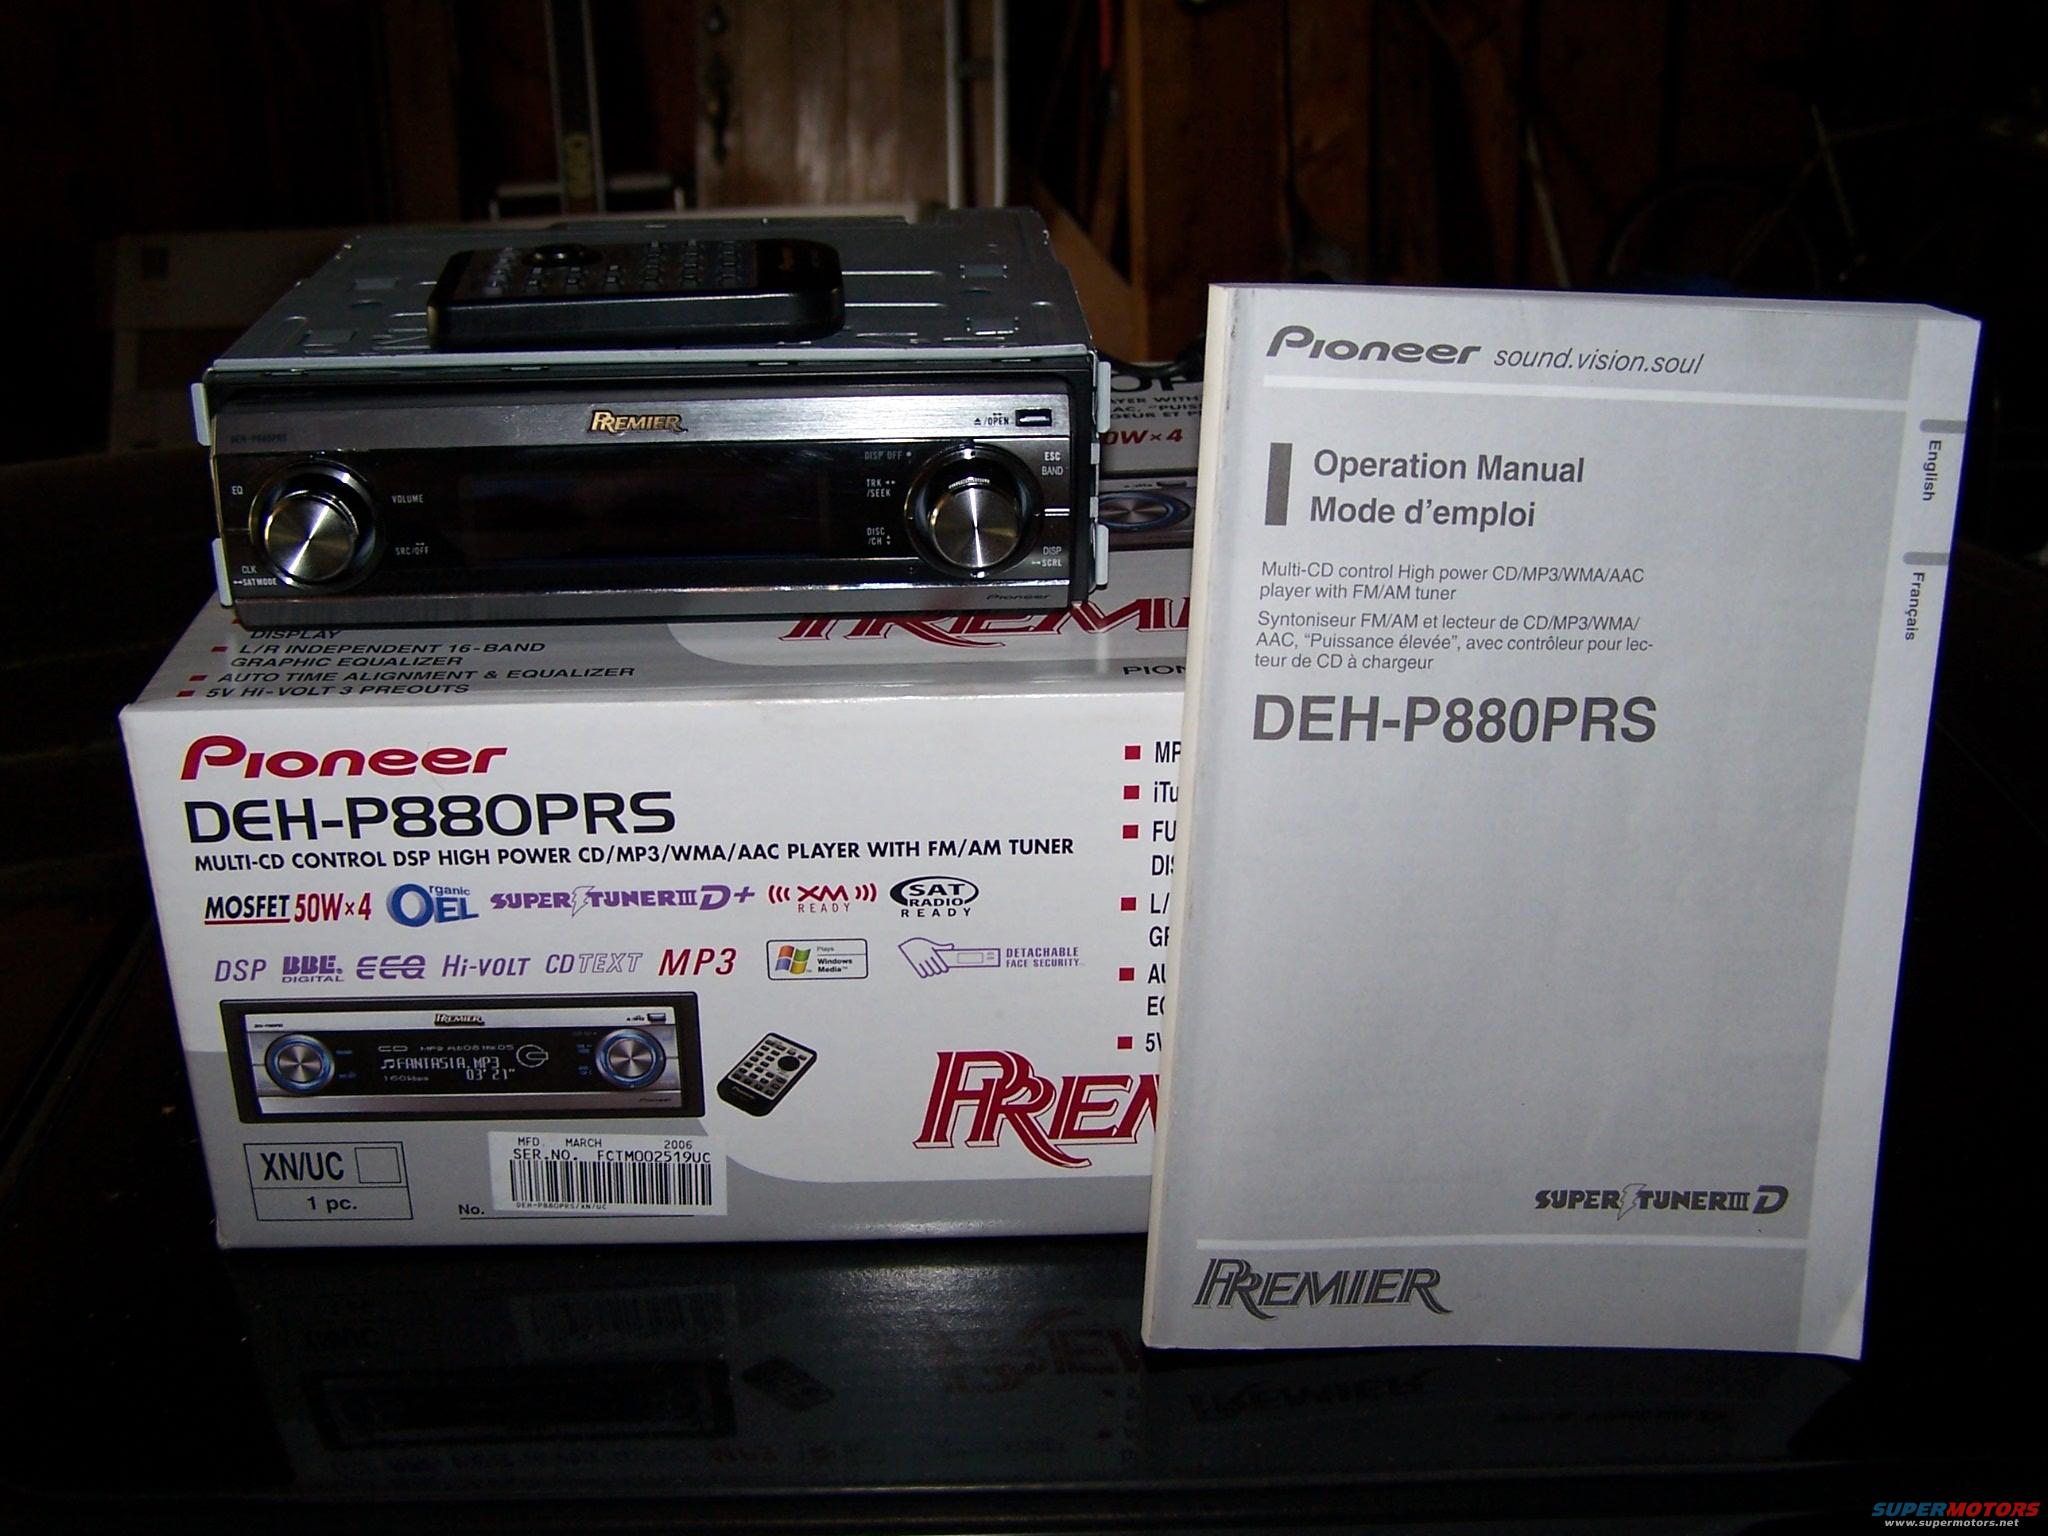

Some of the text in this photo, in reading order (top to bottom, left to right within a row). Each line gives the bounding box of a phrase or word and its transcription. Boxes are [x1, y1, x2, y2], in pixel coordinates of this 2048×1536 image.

[1266, 325, 1705, 375] Pioneer sound.vision.soul
[588, 410, 688, 435] PREMIER
[887, 451, 903, 460] OFF
[1044, 451, 1061, 461] ESC
[1041, 466, 1064, 476] BAND
[1314, 449, 1585, 483] Operation Manual
[1923, 440, 1942, 501] English
[231, 485, 244, 495] EQ
[866, 479, 882, 487] TRK
[391, 494, 424, 504] VOLUME
[1310, 496, 1536, 533] Mode d’emploi
[1042, 546, 1062, 556] DISP
[241, 566, 257, 574] CLK
[1041, 558, 1062, 567] SCRL
[1261, 561, 1645, 584] Multi-CD control High power CD/MP3/WMA/AAC
[1259, 583, 1457, 601] player with FM/AM tuner
[1905, 571, 1925, 641] Français
[1258, 610, 1640, 631] Syntoniseur FM/AM et lecteur de CD/MP3/WMA/
[250, 630, 342, 639] DISPLAY
[239, 642, 546, 654] L/R INDEPENDENT 16-BAND
[1256, 632, 1298, 649] AAC,
[1466, 638, 1503, 651] avec
[1507, 635, 1584, 651] contrôleur
[1588, 639, 1622, 654] pour
[1626, 637, 1654, 652] lec-
[231, 656, 463, 667] GRAPHIC EQUALIZER
[1255, 653, 1434, 673] teur de CD à chargeur
[217, 668, 635, 682] AUTO TIME ALIGNMENT & EQUALIZER
[206, 684, 470, 698] 5V Hi-VOLT 3 PREOUTS
[1253, 695, 1658, 744] DEH-P880PRS
[181, 734, 508, 781] Pioneer
[185, 791, 676, 844] DEH-P880PRS
[195, 838, 1074, 872] MULTI-CD CONTROL DSP HIGH POWER CD/MP3/WMA/AAC PLAYER WITH FM/AM TUNER
[1152, 854, 1174, 876] DI
[797, 885, 849, 901] XM
[909, 883, 965, 896] SAT
[205, 895, 290, 919] MOSFET
[490, 892, 572, 909] SUPER
[798, 903, 850, 913] READY
[909, 897, 963, 907] RADIO
[901, 907, 970, 918] READY
[1006, 947, 1079, 957] DETACHABLE
[442, 954, 531, 977] Hi-VOLT
[658, 948, 737, 976] MP3
[1006, 958, 1079, 968] FACE SECURITY
[215, 959, 267, 982] DSP
[282, 975, 345, 983] DIGITAL
[565, 1137, 602, 1148] MARCH
[664, 1140, 693, 1150] 2006
[597, 1150, 711, 1164] FCTM002519UC
[261, 1152, 345, 1181] XN/UC
[307, 1196, 357, 1213] 1 pc.
[1534, 1190, 1621, 1210] SUPER
[458, 1204, 485, 1215] No.
[1192, 1258, 1452, 1320] PREMIER
